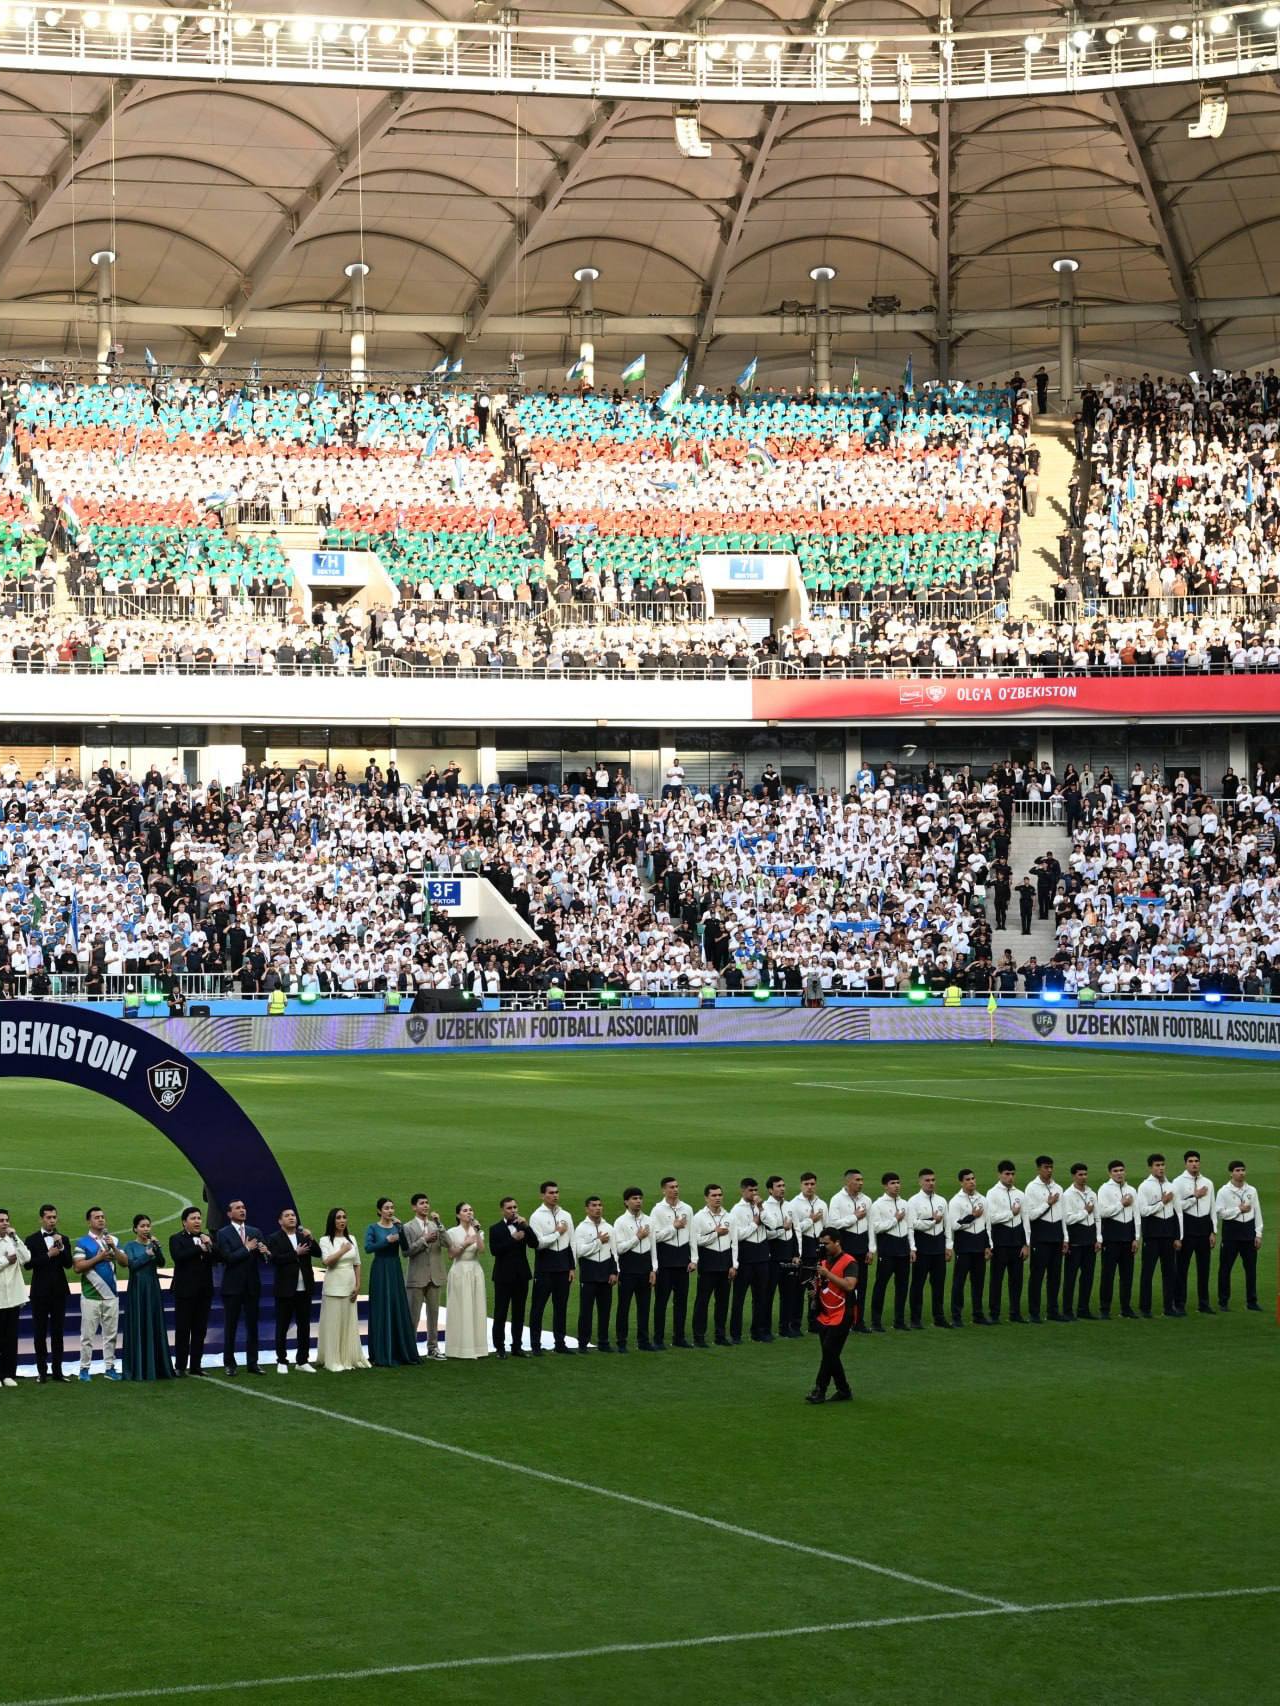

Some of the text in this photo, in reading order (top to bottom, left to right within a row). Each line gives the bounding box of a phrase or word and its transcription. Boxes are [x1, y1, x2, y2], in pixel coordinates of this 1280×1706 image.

[319, 555, 338, 569] 7H
[433, 883, 453, 897] 3F
[436, 1014, 698, 1040] UZBEKISTAN FOOTBALL ASSOCIATION
[1036, 1014, 1053, 1025] UFA
[1066, 1014, 1159, 1036] UZBEKISTAN
[1163, 1016, 1223, 1040] FOOTBALL
[154, 1070, 182, 1087] UFA
